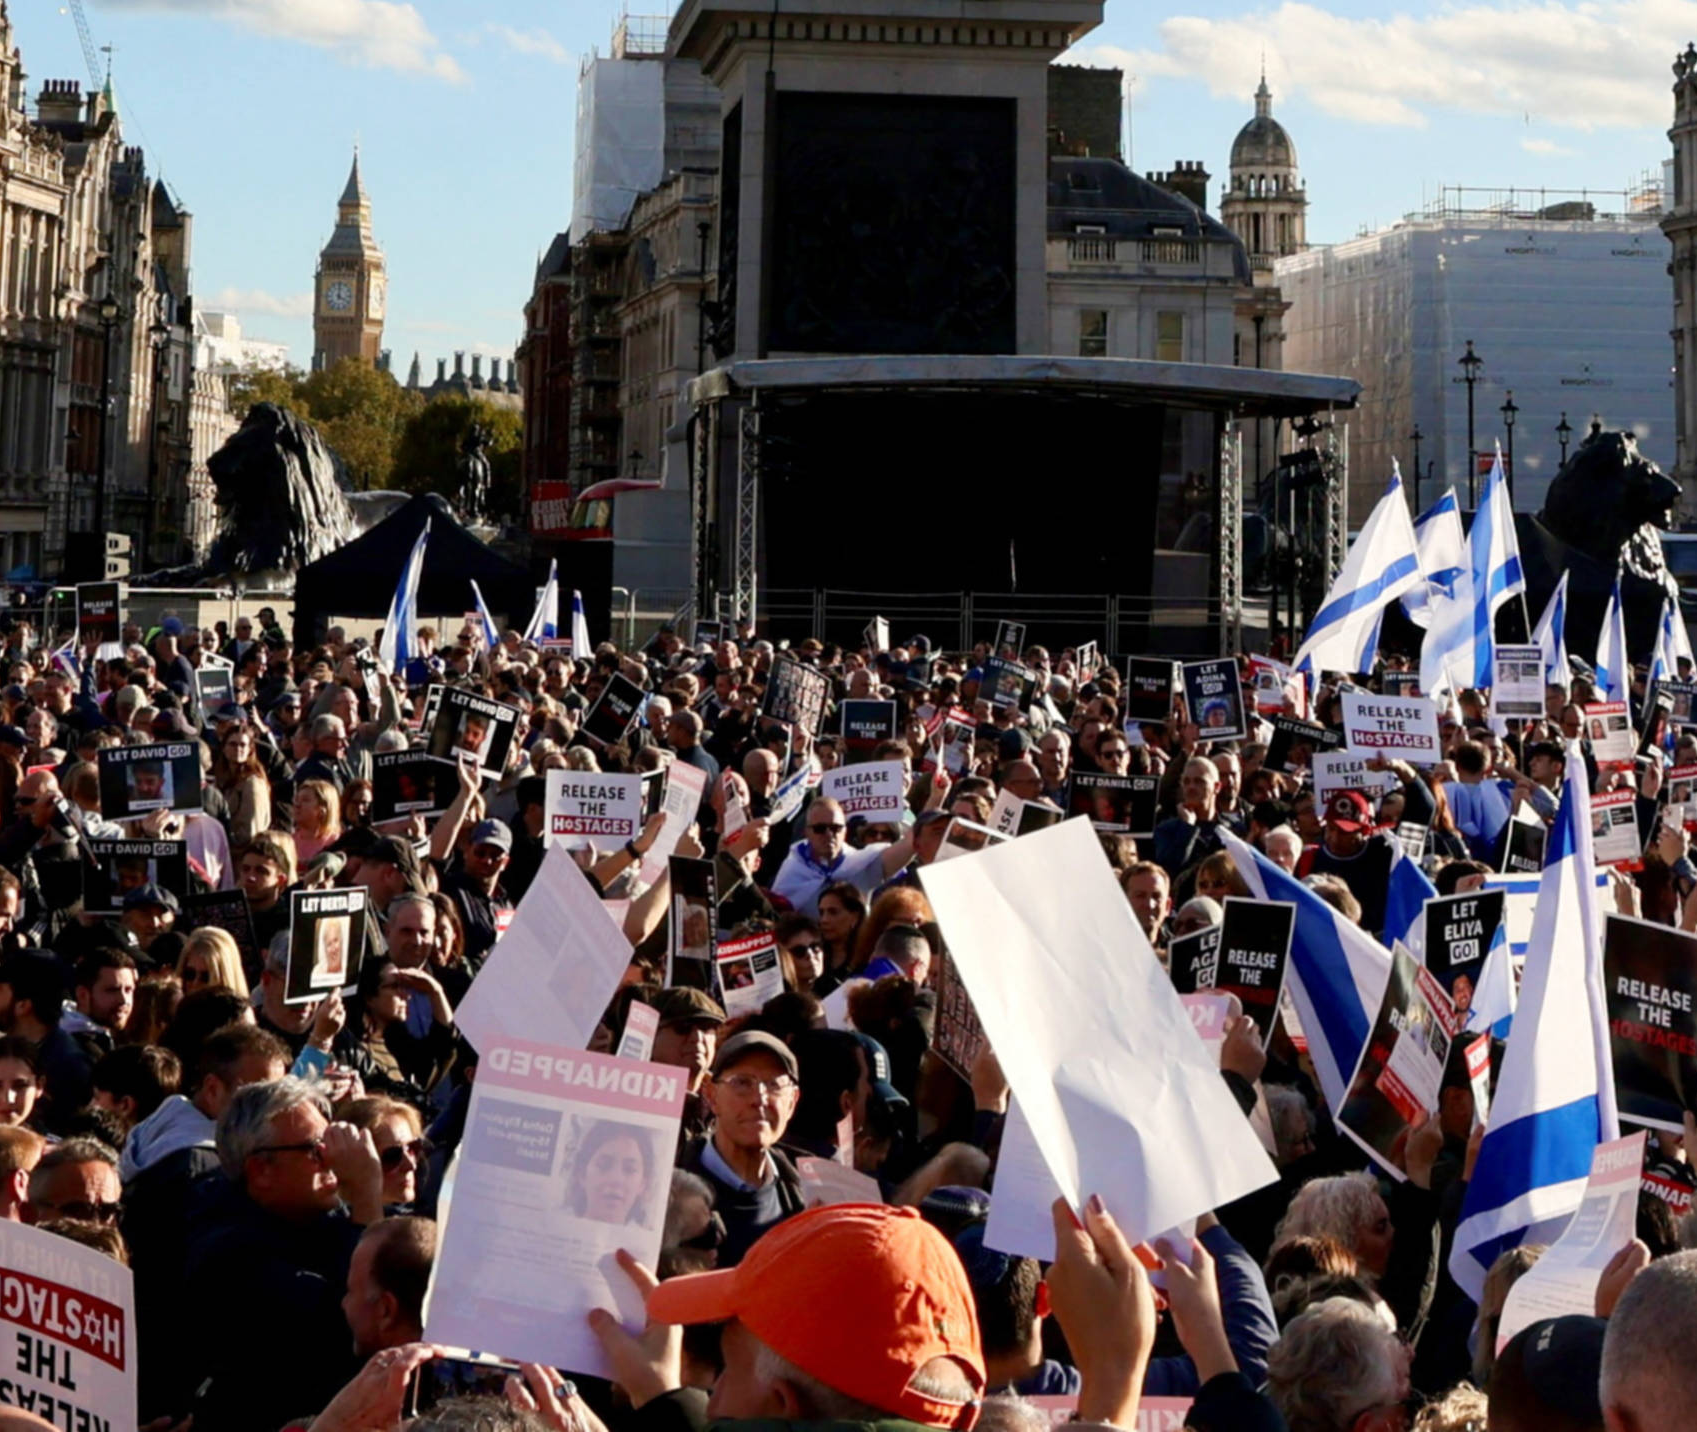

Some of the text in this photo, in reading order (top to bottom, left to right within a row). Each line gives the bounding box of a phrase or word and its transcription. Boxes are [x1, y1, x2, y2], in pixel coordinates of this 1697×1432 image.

[1201, 664, 1217, 674] LET
[1134, 676, 1167, 687] RELEASE
[1195, 673, 1226, 685] ADINA
[451, 694, 497, 714] LET DAVID
[1358, 705, 1422, 720] RELEASE
[850, 721, 887, 732] RELEASE
[1278, 721, 1293, 732] LET
[1377, 720, 1405, 731] THE
[860, 730, 877, 739] THE
[108, 750, 129, 762] LET
[131, 747, 167, 760] DAVID
[378, 755, 395, 767] LET
[1327, 762, 1365, 774] RELEA
[834, 771, 889, 790] RELEASE
[1077, 776, 1095, 786] LET
[1097, 777, 1132, 788] DANIEL
[561, 783, 627, 800] RELEASE
[848, 785, 874, 797] THE
[578, 801, 606, 816] THE
[843, 797, 898, 811] STAGES
[94, 844, 113, 854] LET
[116, 844, 151, 855] DAVID
[302, 898, 319, 913] LET
[1452, 901, 1478, 920] LET
[1444, 921, 1483, 941] ELIYA
[717, 934, 773, 956] KIDNAPPED
[1200, 933, 1219, 950] LE
[1227, 948, 1277, 969] RELEASE
[1452, 942, 1478, 961] GO!
[1240, 968, 1262, 986] THE
[1617, 976, 1692, 1013] RELEASE
[1637, 1002, 1673, 1028] THE
[16, 1331, 76, 1392] THE
